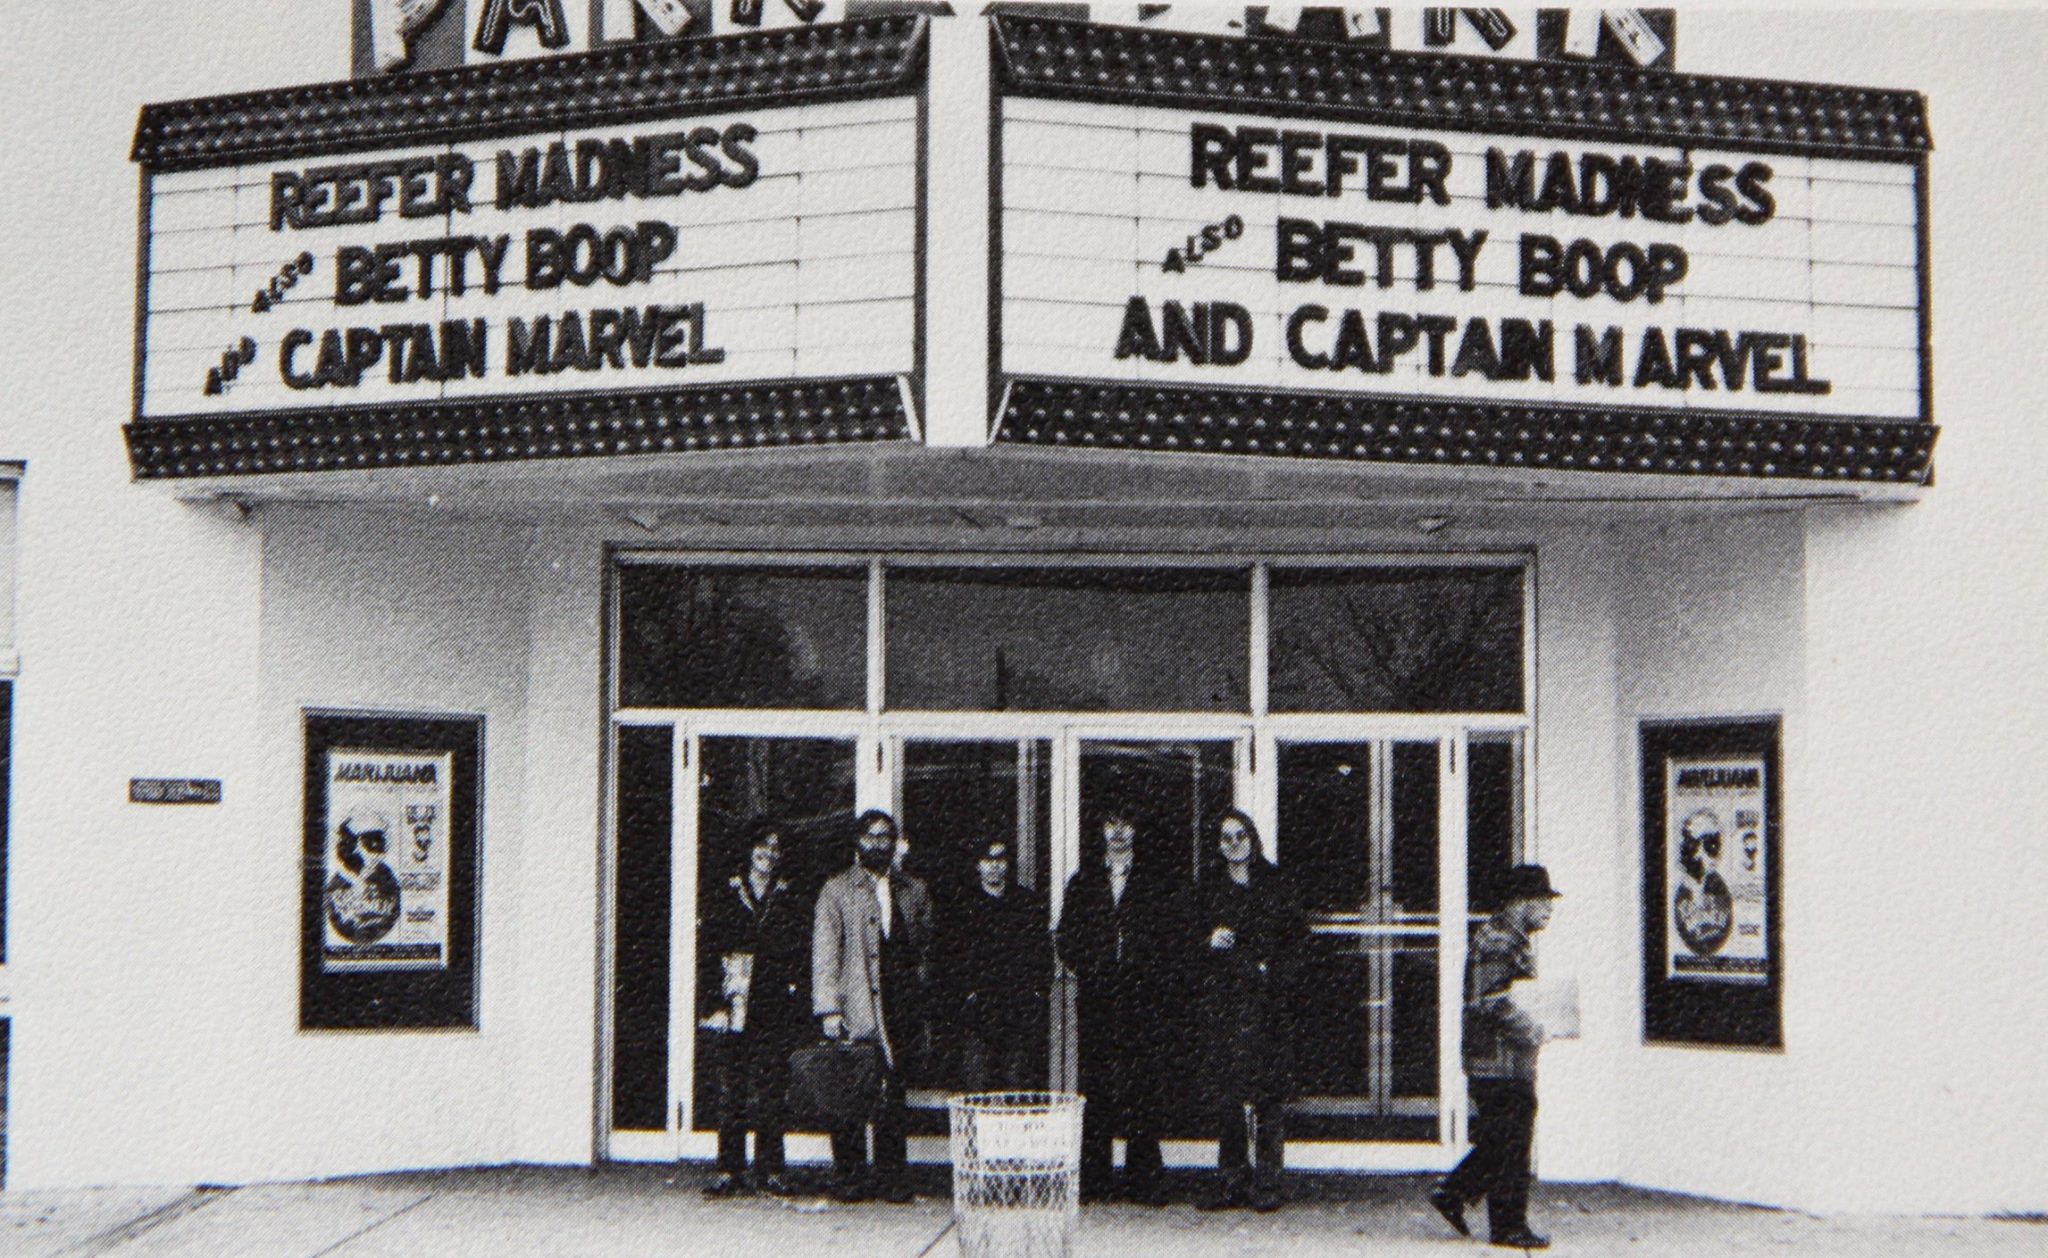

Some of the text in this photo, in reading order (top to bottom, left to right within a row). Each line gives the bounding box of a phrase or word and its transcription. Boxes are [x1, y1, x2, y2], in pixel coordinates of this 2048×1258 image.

[269, 124, 760, 232] REEFER MADNESS
[1188, 122, 1776, 226] REEFER MADNESS
[251, 220, 678, 314] ALSO BETTY BOOP
[1161, 213, 1689, 305] ALSO BETTY BOOP
[203, 302, 725, 397] AND CAPTAIN MARVEL
[1114, 296, 1831, 395] AND CAPTAIN MARVEL
